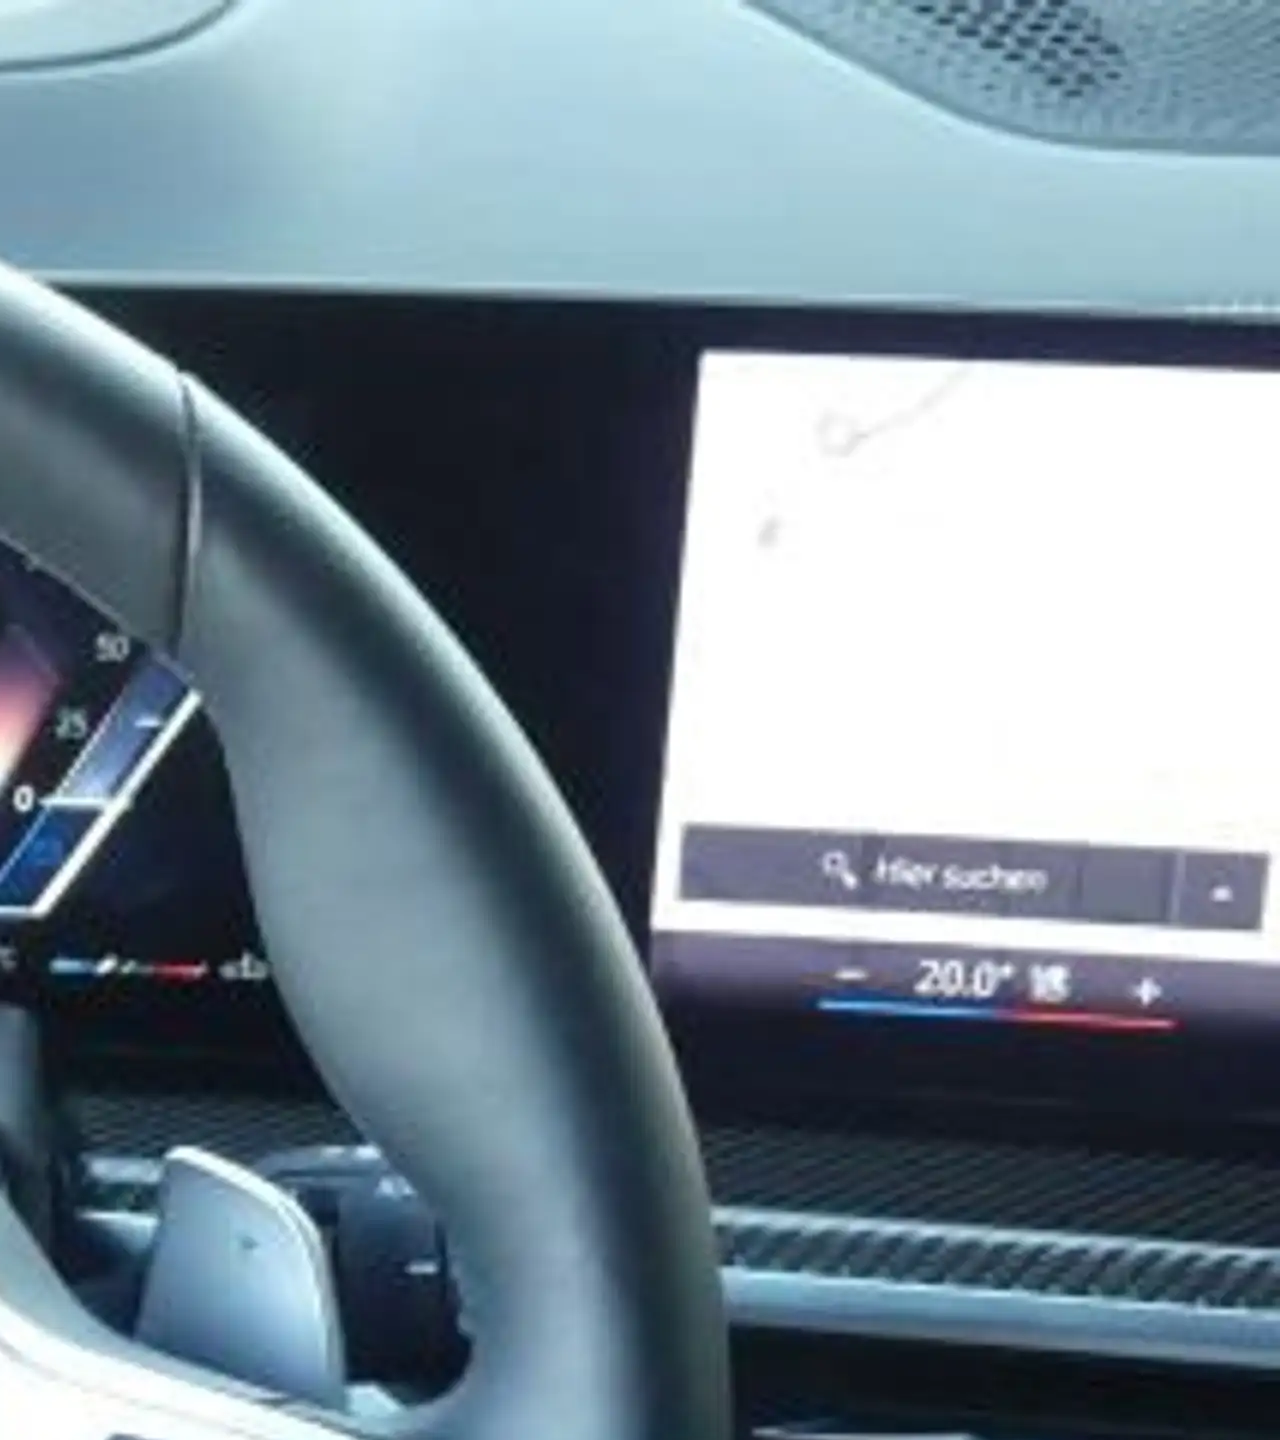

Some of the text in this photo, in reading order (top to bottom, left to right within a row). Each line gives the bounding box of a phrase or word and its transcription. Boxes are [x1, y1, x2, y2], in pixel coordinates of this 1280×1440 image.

[13, 785, 34, 813] 0
[872, 855, 1048, 893] Hier suchen
